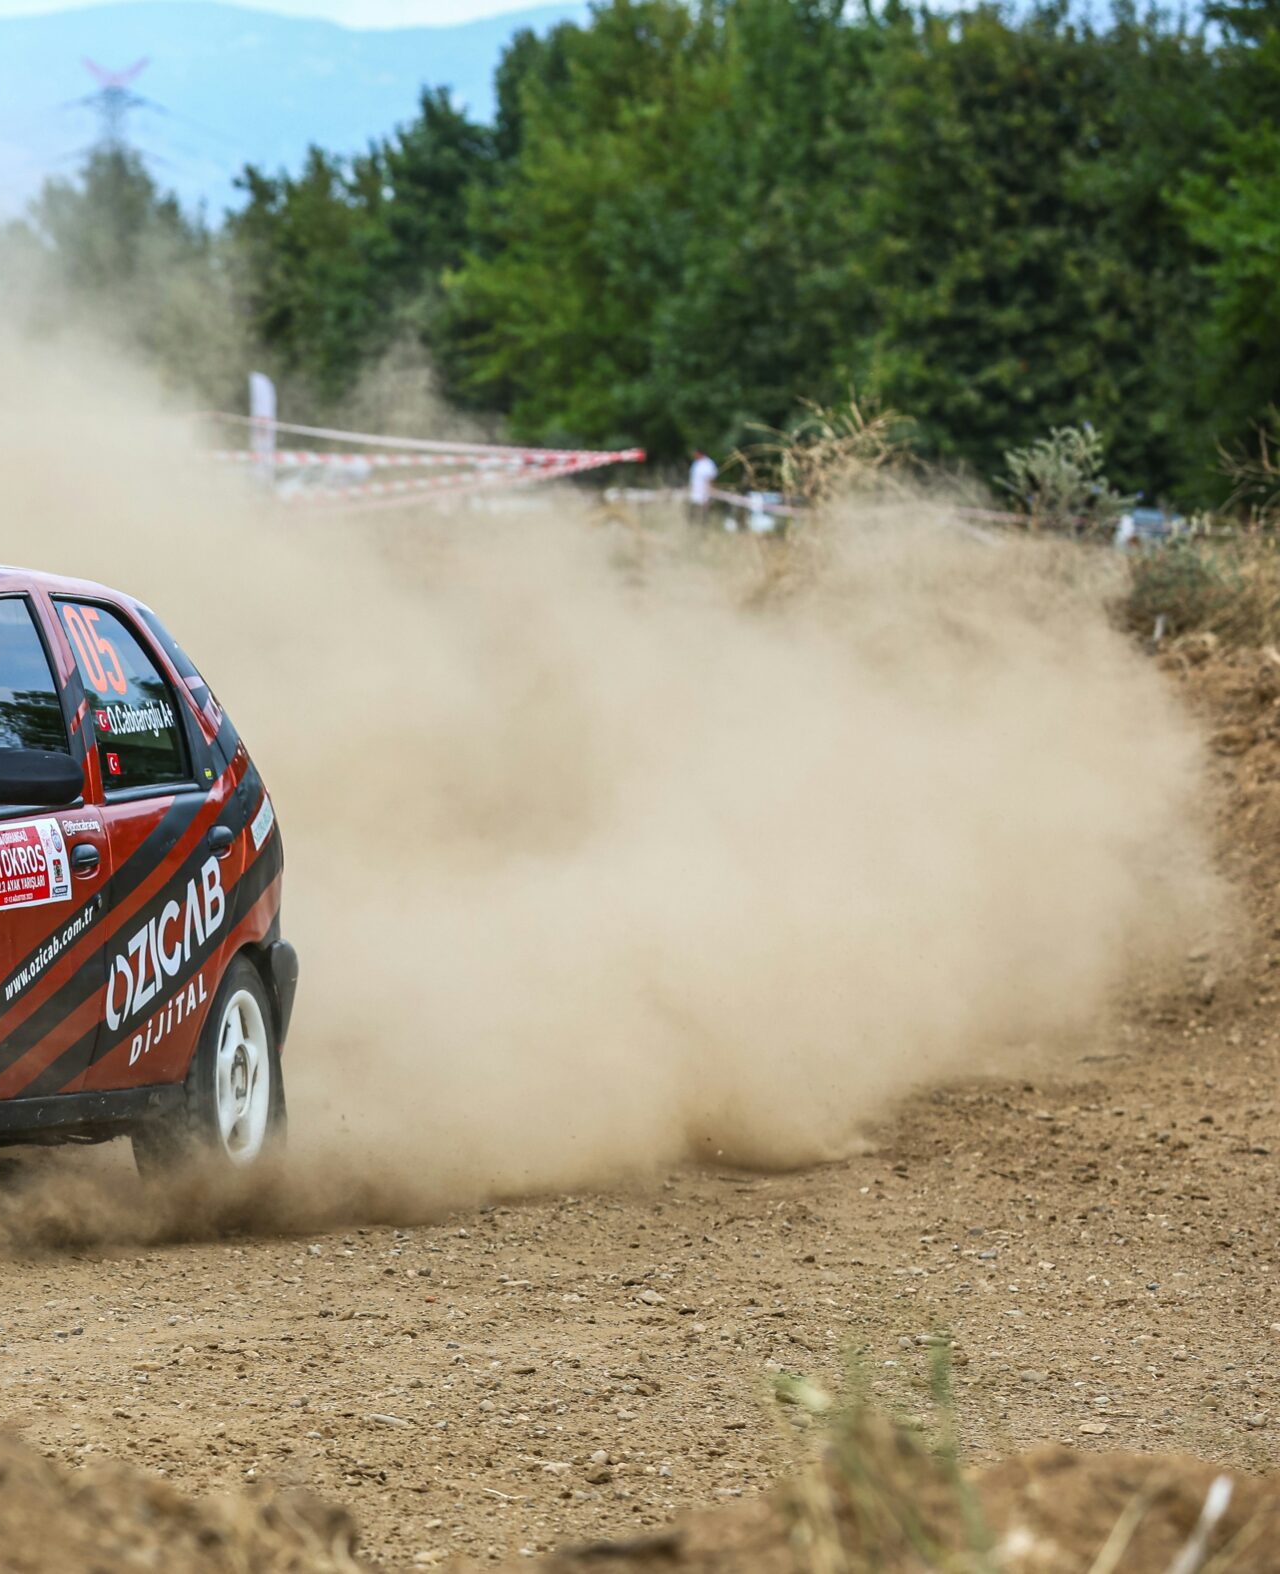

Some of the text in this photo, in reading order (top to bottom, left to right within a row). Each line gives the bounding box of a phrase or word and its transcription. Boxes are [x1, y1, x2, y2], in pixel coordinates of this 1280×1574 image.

[63, 605, 127, 695] 05
[7, 878, 21, 892] AYAK
[5, 905, 93, 1001] www.ozicab.com.tr
[106, 855, 225, 1031] OZICAB
